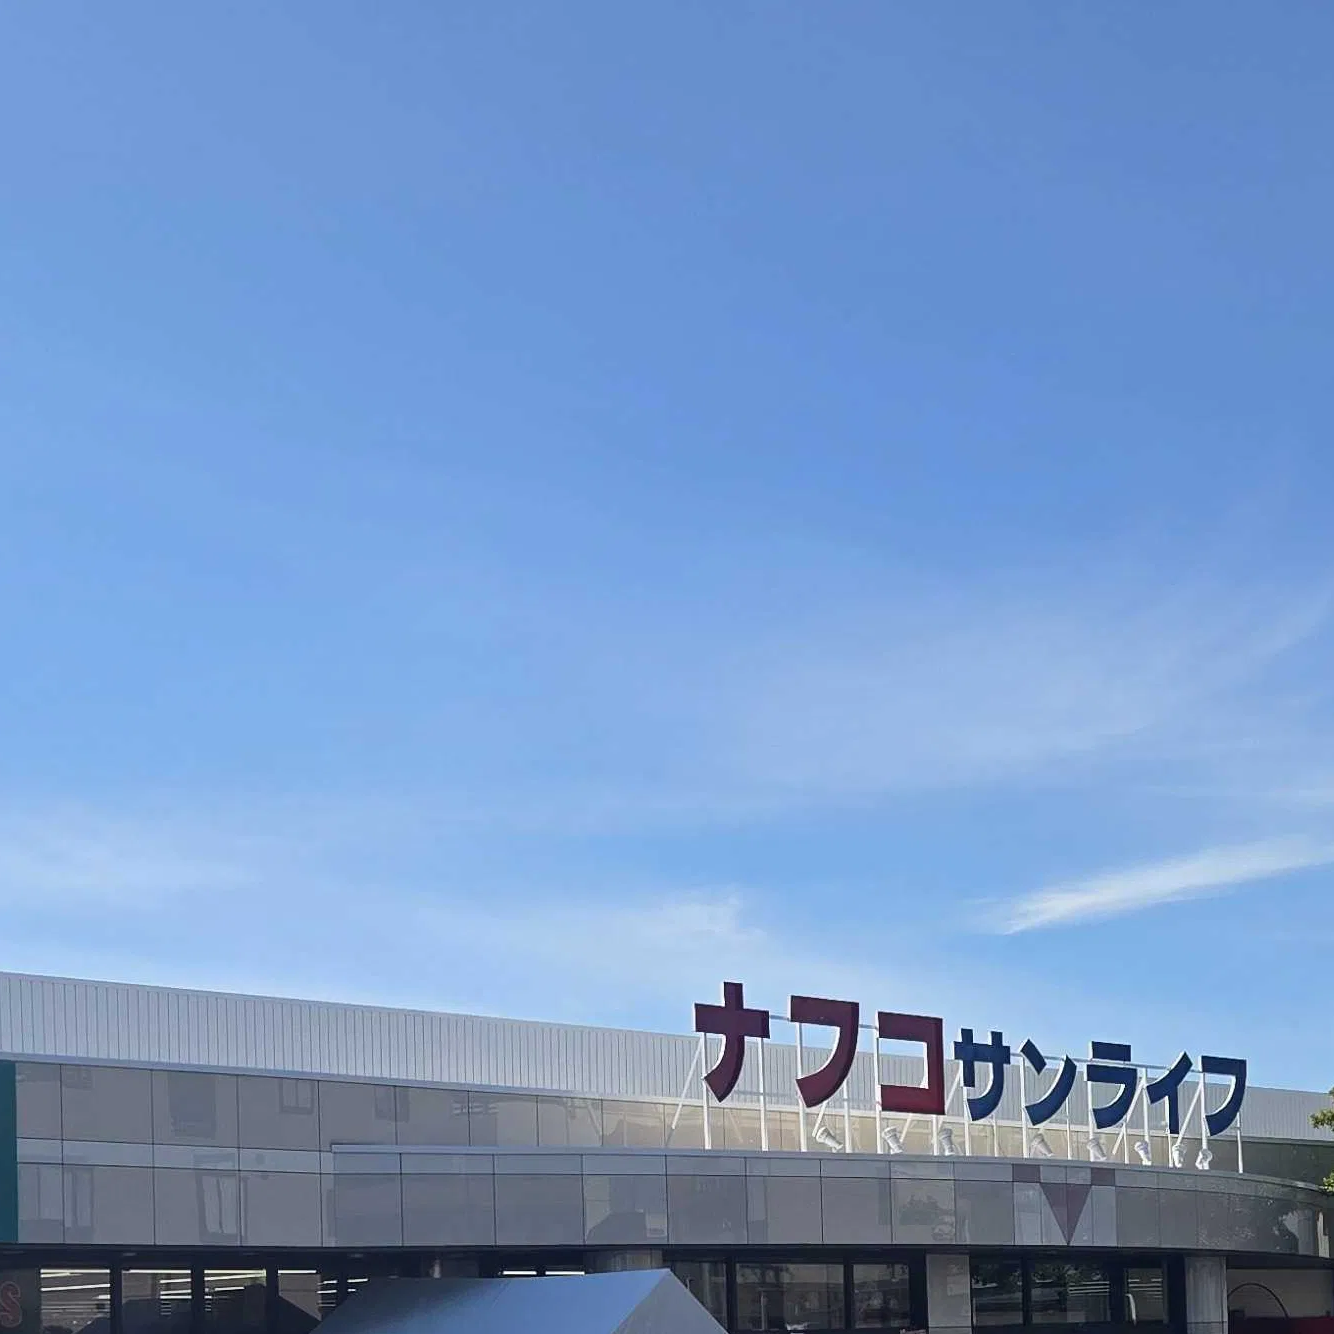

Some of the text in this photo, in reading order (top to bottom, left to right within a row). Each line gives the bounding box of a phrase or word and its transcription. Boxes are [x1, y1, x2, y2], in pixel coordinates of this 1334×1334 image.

[694, 981, 1248, 1137] ナフコ サンライフ
